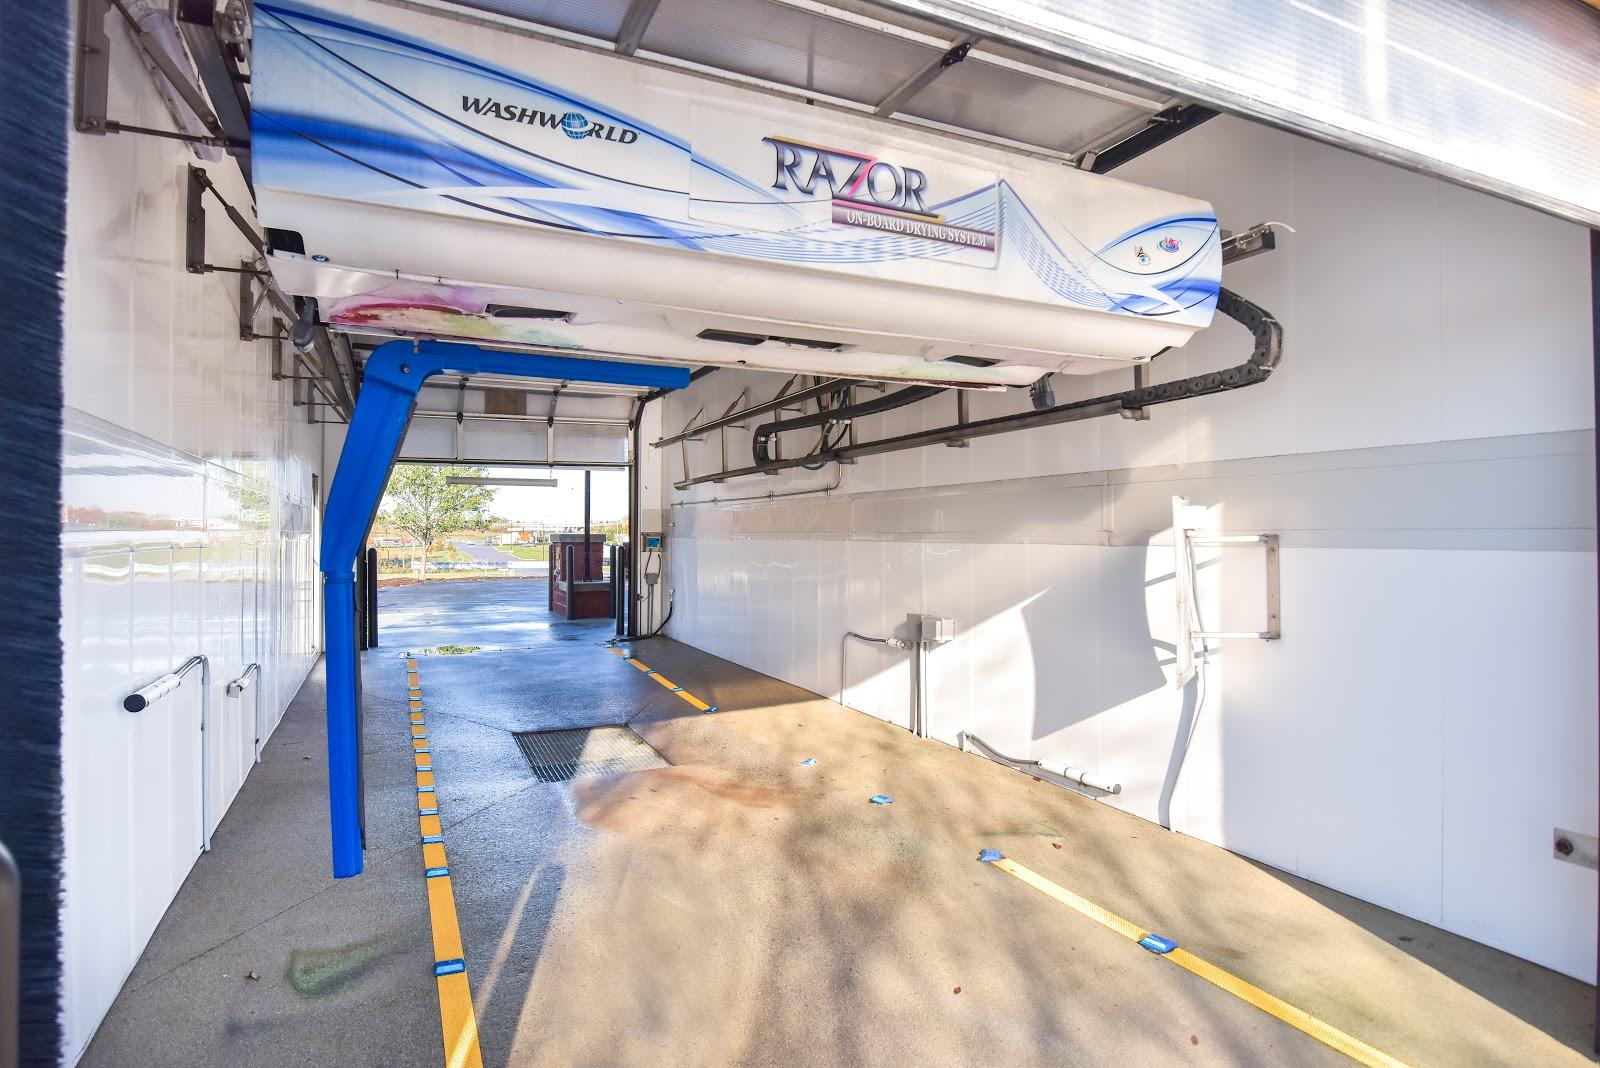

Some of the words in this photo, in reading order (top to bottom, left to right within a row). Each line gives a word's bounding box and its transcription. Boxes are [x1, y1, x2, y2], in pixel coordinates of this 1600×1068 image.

[765, 138, 929, 212] RAZOR
[847, 209, 904, 232] ON-BOARD
[906, 220, 947, 241] DRYING
[947, 230, 987, 248] SYSTEM
